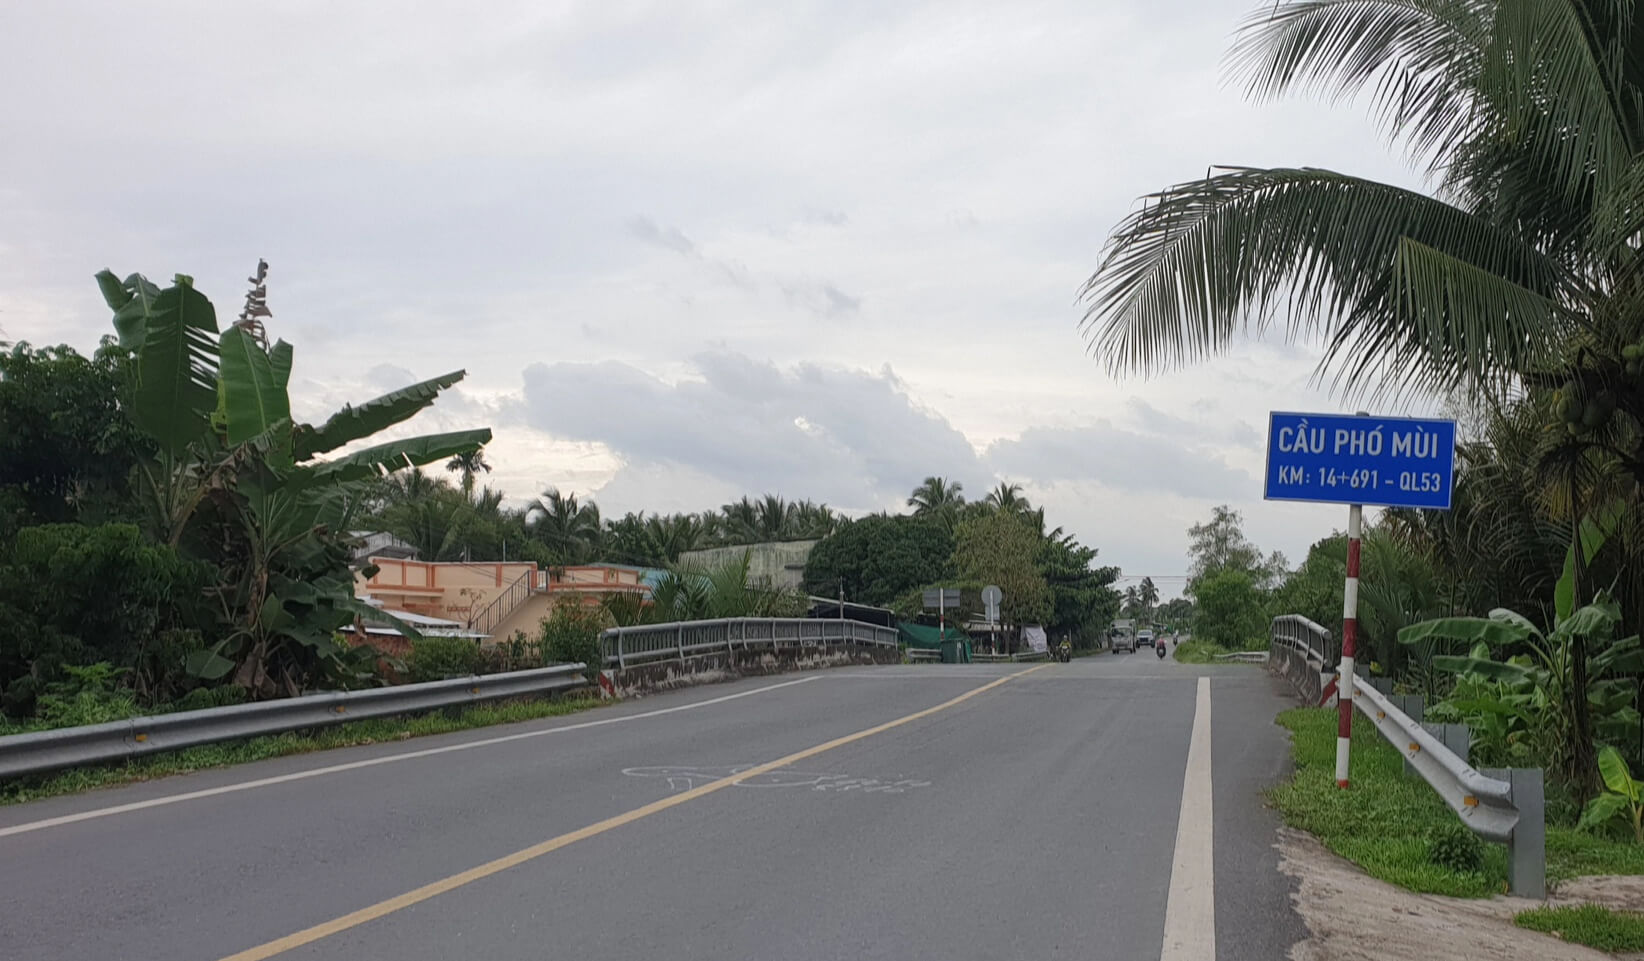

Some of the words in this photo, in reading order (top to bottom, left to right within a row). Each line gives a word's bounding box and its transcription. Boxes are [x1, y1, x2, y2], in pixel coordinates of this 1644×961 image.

[1278, 418, 1326, 454] CẦU
[1333, 424, 1384, 456] PHÓ
[1391, 425, 1438, 459] MÙI
[1278, 465, 1311, 485] KM:
[1318, 467, 1378, 490] 14+691
[1399, 471, 1441, 492] QL53
